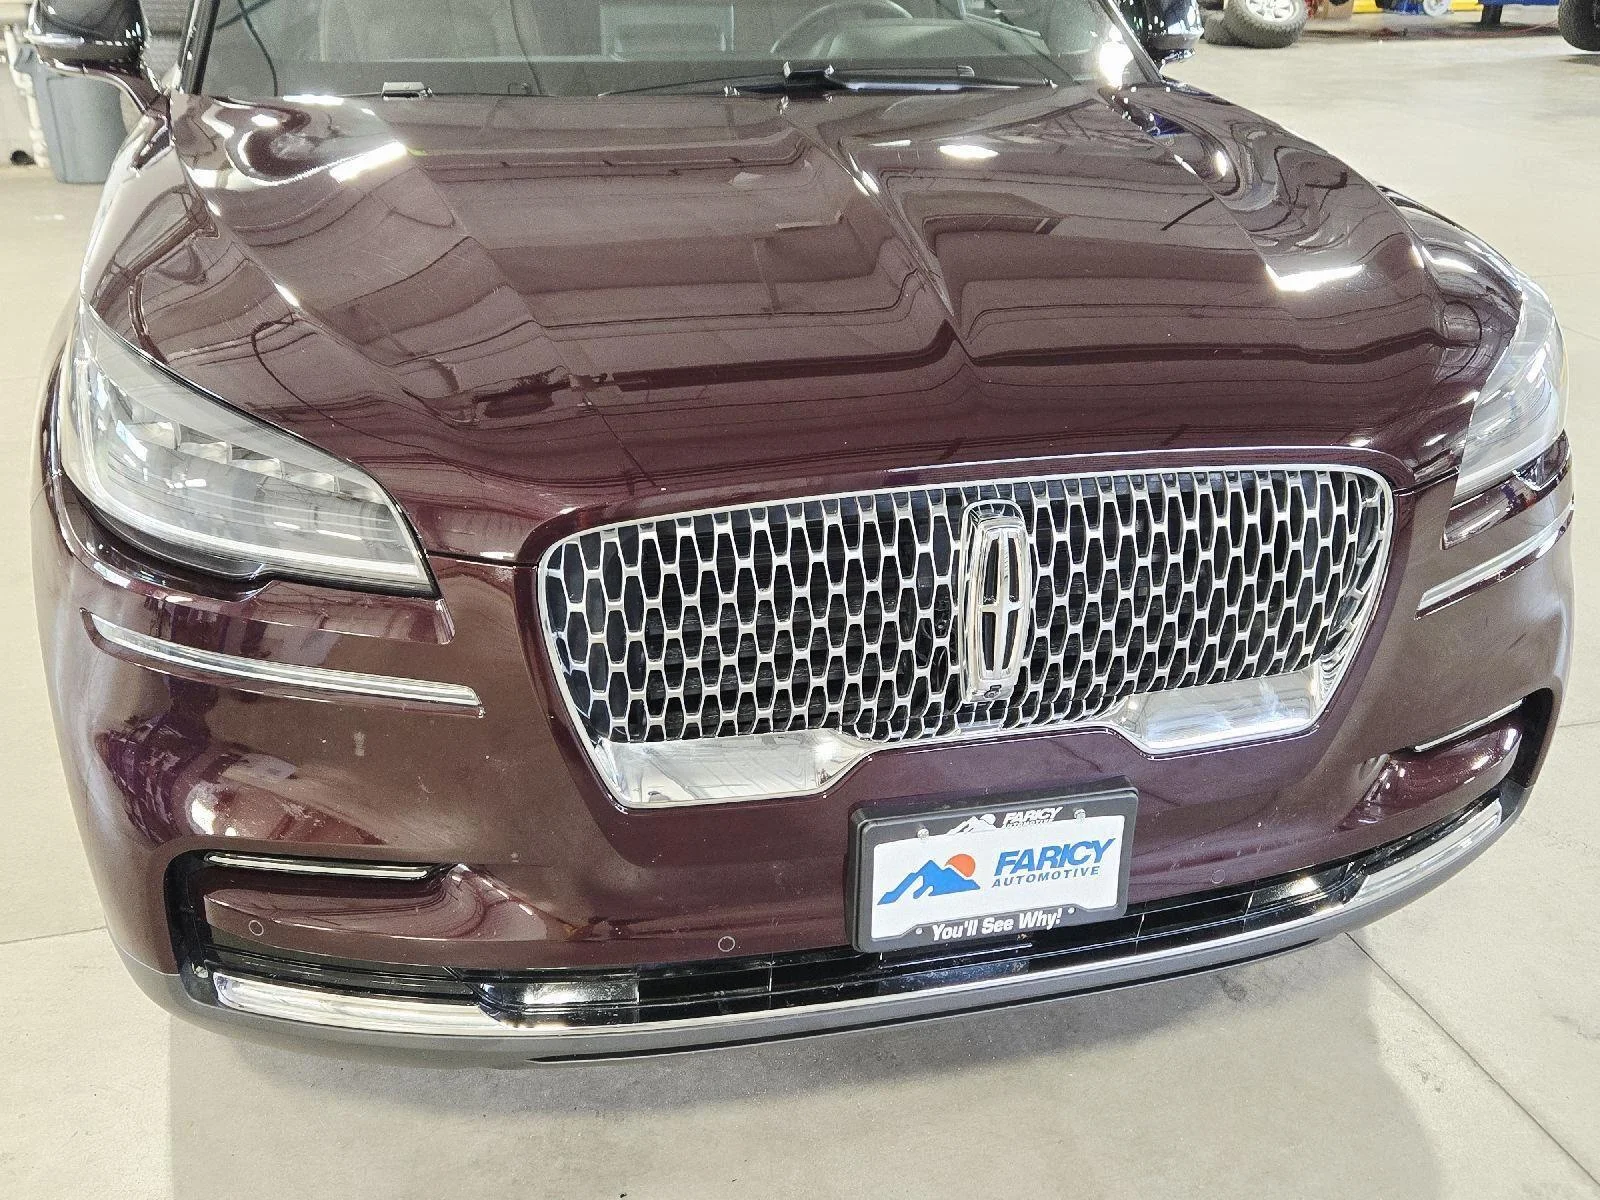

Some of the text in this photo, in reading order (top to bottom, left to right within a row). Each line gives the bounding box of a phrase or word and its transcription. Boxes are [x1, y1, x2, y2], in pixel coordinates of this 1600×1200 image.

[1003, 807, 1063, 825] FARICY
[995, 838, 1116, 877] FARICY
[991, 866, 1100, 888] AUTOMOTIVE
[932, 908, 1062, 941] You'll See Why!
